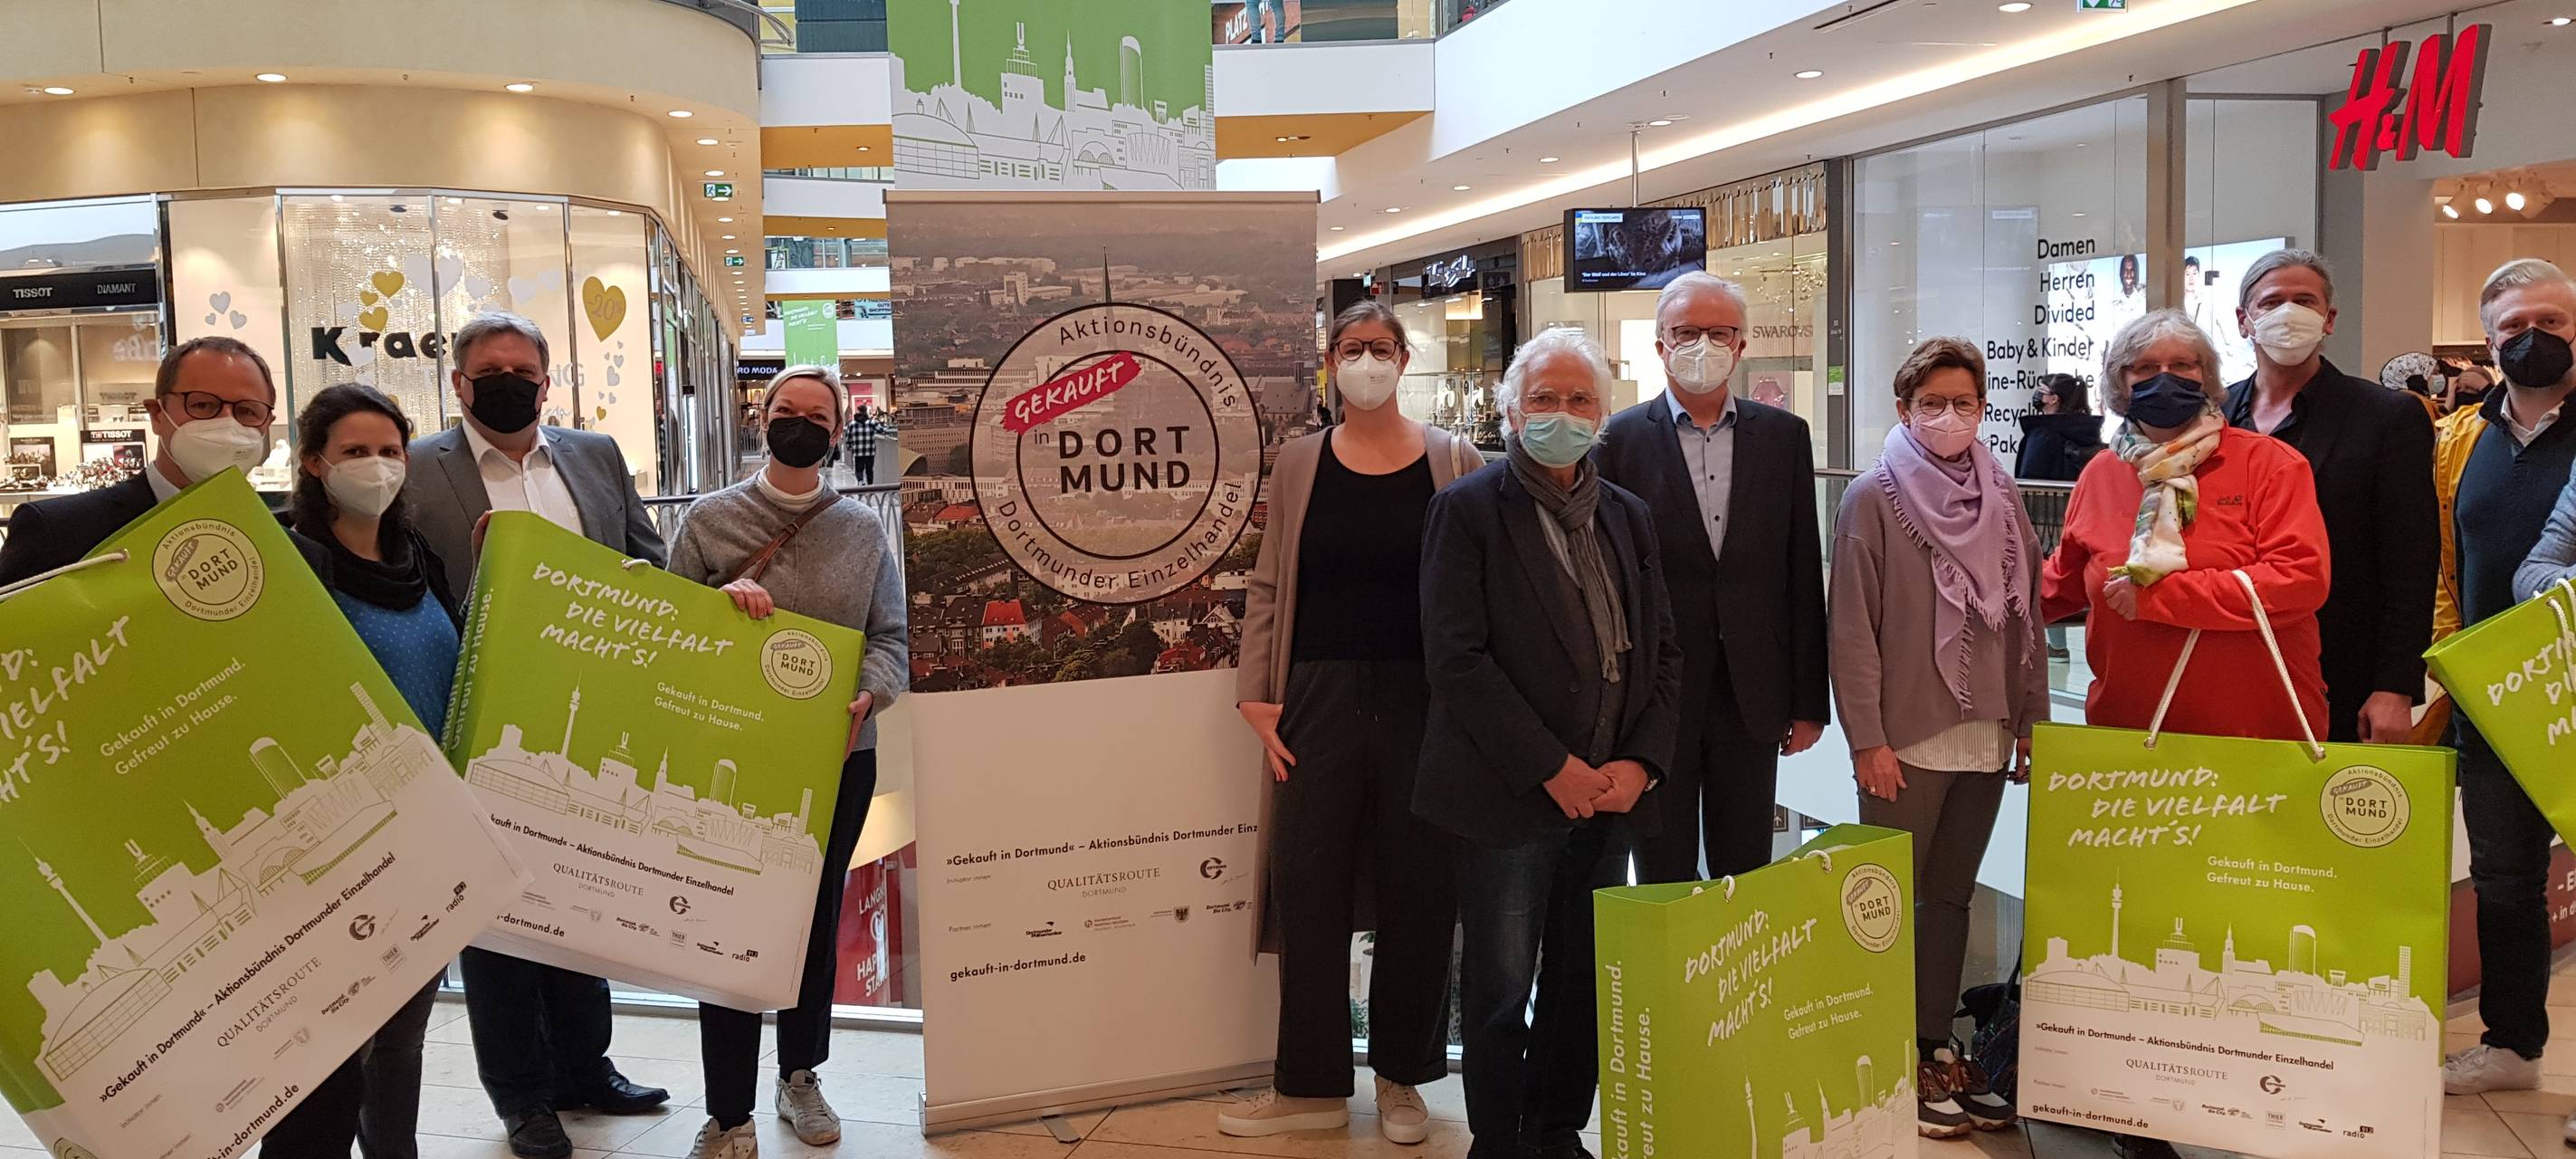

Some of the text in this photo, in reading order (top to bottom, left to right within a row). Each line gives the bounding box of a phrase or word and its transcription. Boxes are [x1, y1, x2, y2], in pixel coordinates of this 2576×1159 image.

[2328, 24, 2491, 171] H&M
[2038, 238, 2095, 259] Damen
[13, 286, 53, 299] TISSOT
[97, 283, 136, 295] DIAMANT
[2040, 272, 2094, 292] Herren
[2035, 301, 2094, 325] Divided
[311, 327, 457, 367] Krae
[1059, 316, 1236, 407] Aktionsbündnis
[1988, 336, 2094, 364] Baby & Kinder
[1015, 361, 1124, 424] GEKAUFT
[102, 430, 132, 439] TISSOT
[1035, 430, 1049, 445] in
[1058, 426, 1190, 459] DORT
[1060, 461, 1191, 493] MUND
[999, 482, 1243, 589] Dortmunder Einzelhandel
[188, 549, 230, 580] DORT
[196, 560, 238, 590] MUND
[532, 562, 680, 621] DORTMUND:
[472, 588, 494, 648] Hause.
[566, 601, 734, 656] DIE VIELFALT
[781, 661, 814, 675] MUND
[782, 653, 816, 667] DORT
[0, 616, 129, 740] IELFALT
[100, 657, 246, 757] Gekauft in Dortmund.
[654, 696, 743, 731] Gefreut zu Hause.
[657, 681, 764, 722] Gekauft in Dortmund.
[115, 694, 238, 775] Gefreut zu Hause.
[2048, 766, 2218, 791] DORTMUND:
[2091, 793, 2287, 819] DIE VIELFALT
[2345, 797, 2388, 809] DORT
[2345, 807, 2387, 819] MUND
[513, 821, 521, 833] in
[576, 843, 636, 869] Aktionsbündnis
[637, 860, 684, 883] Dortmunder
[685, 875, 734, 896] Einzelhandel
[947, 850, 997, 867] »Gekauft
[1000, 849, 1011, 860] in
[1015, 842, 1074, 858] Dortmund«
[1088, 832, 1169, 850] Aktionsbündnis
[1173, 825, 1235, 841] Dortmunder
[552, 862, 644, 896] QUALITÄTSROUTE
[1047, 867, 1160, 891] QUALITÄTSROUTE
[2207, 855, 2338, 879] Gekauft in Dortmund.
[1083, 886, 1127, 898] DORTMUND
[2207, 871, 2315, 894] Gefreut zu Hause.
[445, 895, 464, 913] radio
[1859, 896, 1889, 912] DORT
[1862, 906, 1891, 922] MUND
[497, 913, 566, 938] -dortmund.de
[731, 952, 750, 963] radio
[1684, 908, 1770, 983] DORTMUND:
[1718, 917, 1818, 1003] DIE VIELFALT
[99, 1059, 148, 1102] »Gekauft
[145, 1052, 159, 1065] in
[215, 943, 286, 1006] Aktionsbündnis
[284, 897, 342, 946] Dortmunder
[340, 851, 396, 902] Einzelhandel
[950, 952, 1086, 982] gekauft-in-dortmund.de
[215, 955, 323, 1048] QUALITÄTSROUTE
[255, 995, 299, 1033] DORTMUND
[1784, 982, 1874, 1020] Gekauft in Dortmund.
[1605, 960, 1626, 1074] Dortmund.
[1789, 1010, 1862, 1039] Gefreut zu Hause.
[1636, 1007, 1654, 1115] zu Hause.
[2077, 1027, 2085, 1037] in
[2147, 1036, 2215, 1054] Aktionsbündnis
[2218, 1046, 2273, 1061] Dortmunder
[2275, 1053, 2334, 1070] Einzelhandel
[2126, 1058, 2228, 1080] QUALITÄTSROUTE
[1611, 1082, 1627, 1102] in
[206, 1083, 300, 1159] t-in-dortmund.de
[2033, 1103, 2149, 1129] gekauft-in-dortmund.de
[2342, 1129, 2365, 1139] radio
